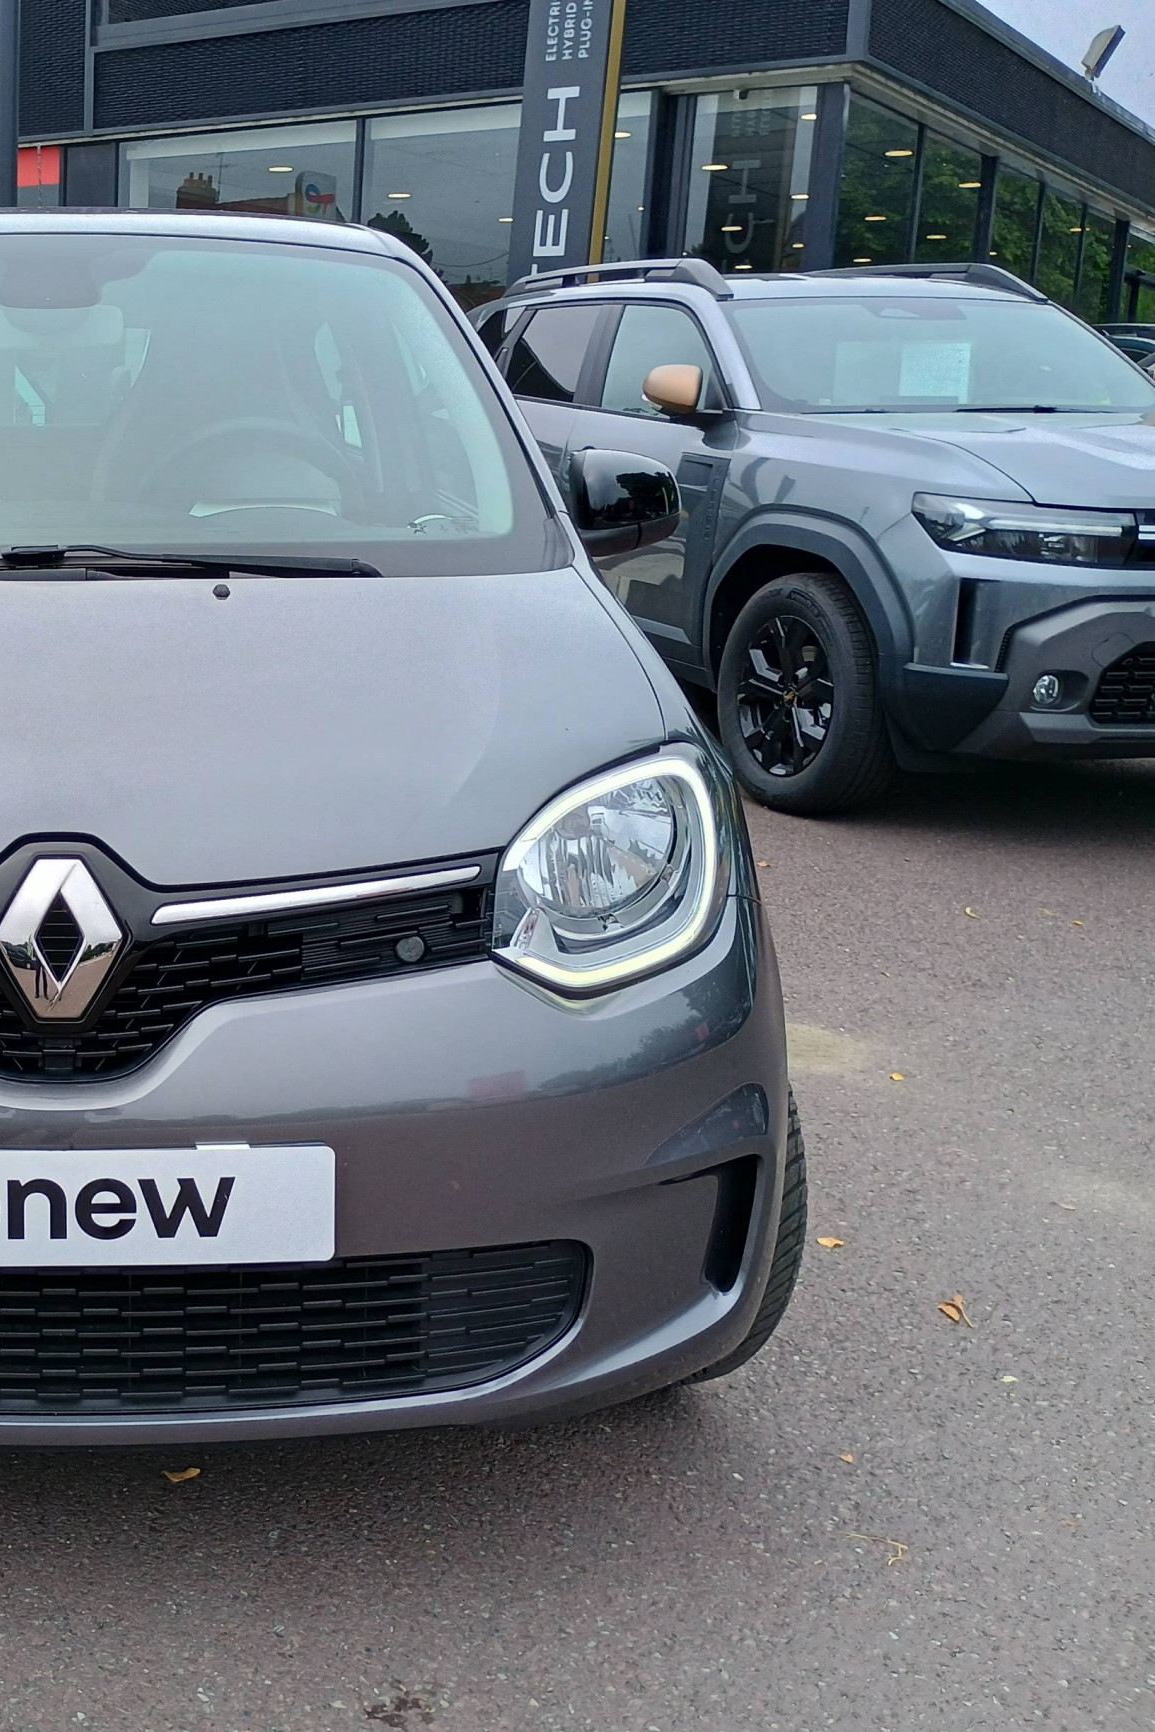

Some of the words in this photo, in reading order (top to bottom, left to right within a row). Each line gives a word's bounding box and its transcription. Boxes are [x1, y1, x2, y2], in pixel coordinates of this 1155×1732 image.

[545, 0, 561, 61] ELECTRI
[561, 2, 577, 60] HYBRID
[531, 86, 580, 275] ECH
